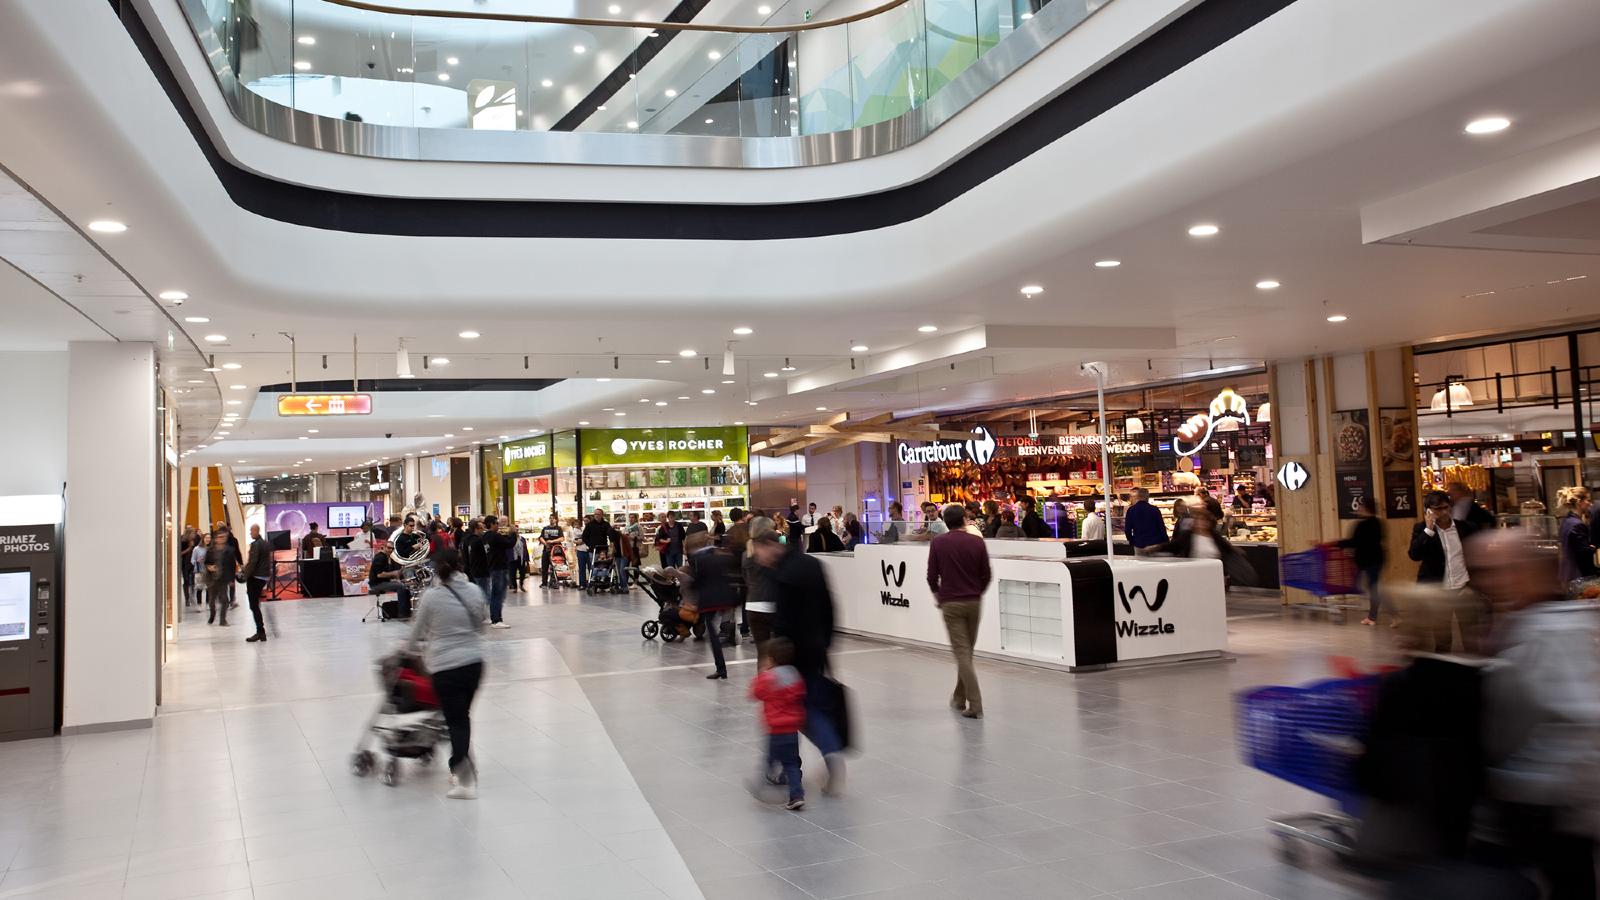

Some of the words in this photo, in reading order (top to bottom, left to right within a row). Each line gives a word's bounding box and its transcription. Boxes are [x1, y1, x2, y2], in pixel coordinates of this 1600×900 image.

[630, 440, 664, 451] YVES
[668, 439, 724, 450] ROCHER
[1018, 445, 1073, 456] BIENVENUE
[1105, 443, 1151, 454] WELCOME
[898, 440, 962, 465] Carrefour
[0, 535, 37, 544] RIMEZ
[4, 543, 50, 552] PHOTOS
[880, 590, 910, 608] Wizzle
[1115, 617, 1175, 638] Wizzle
